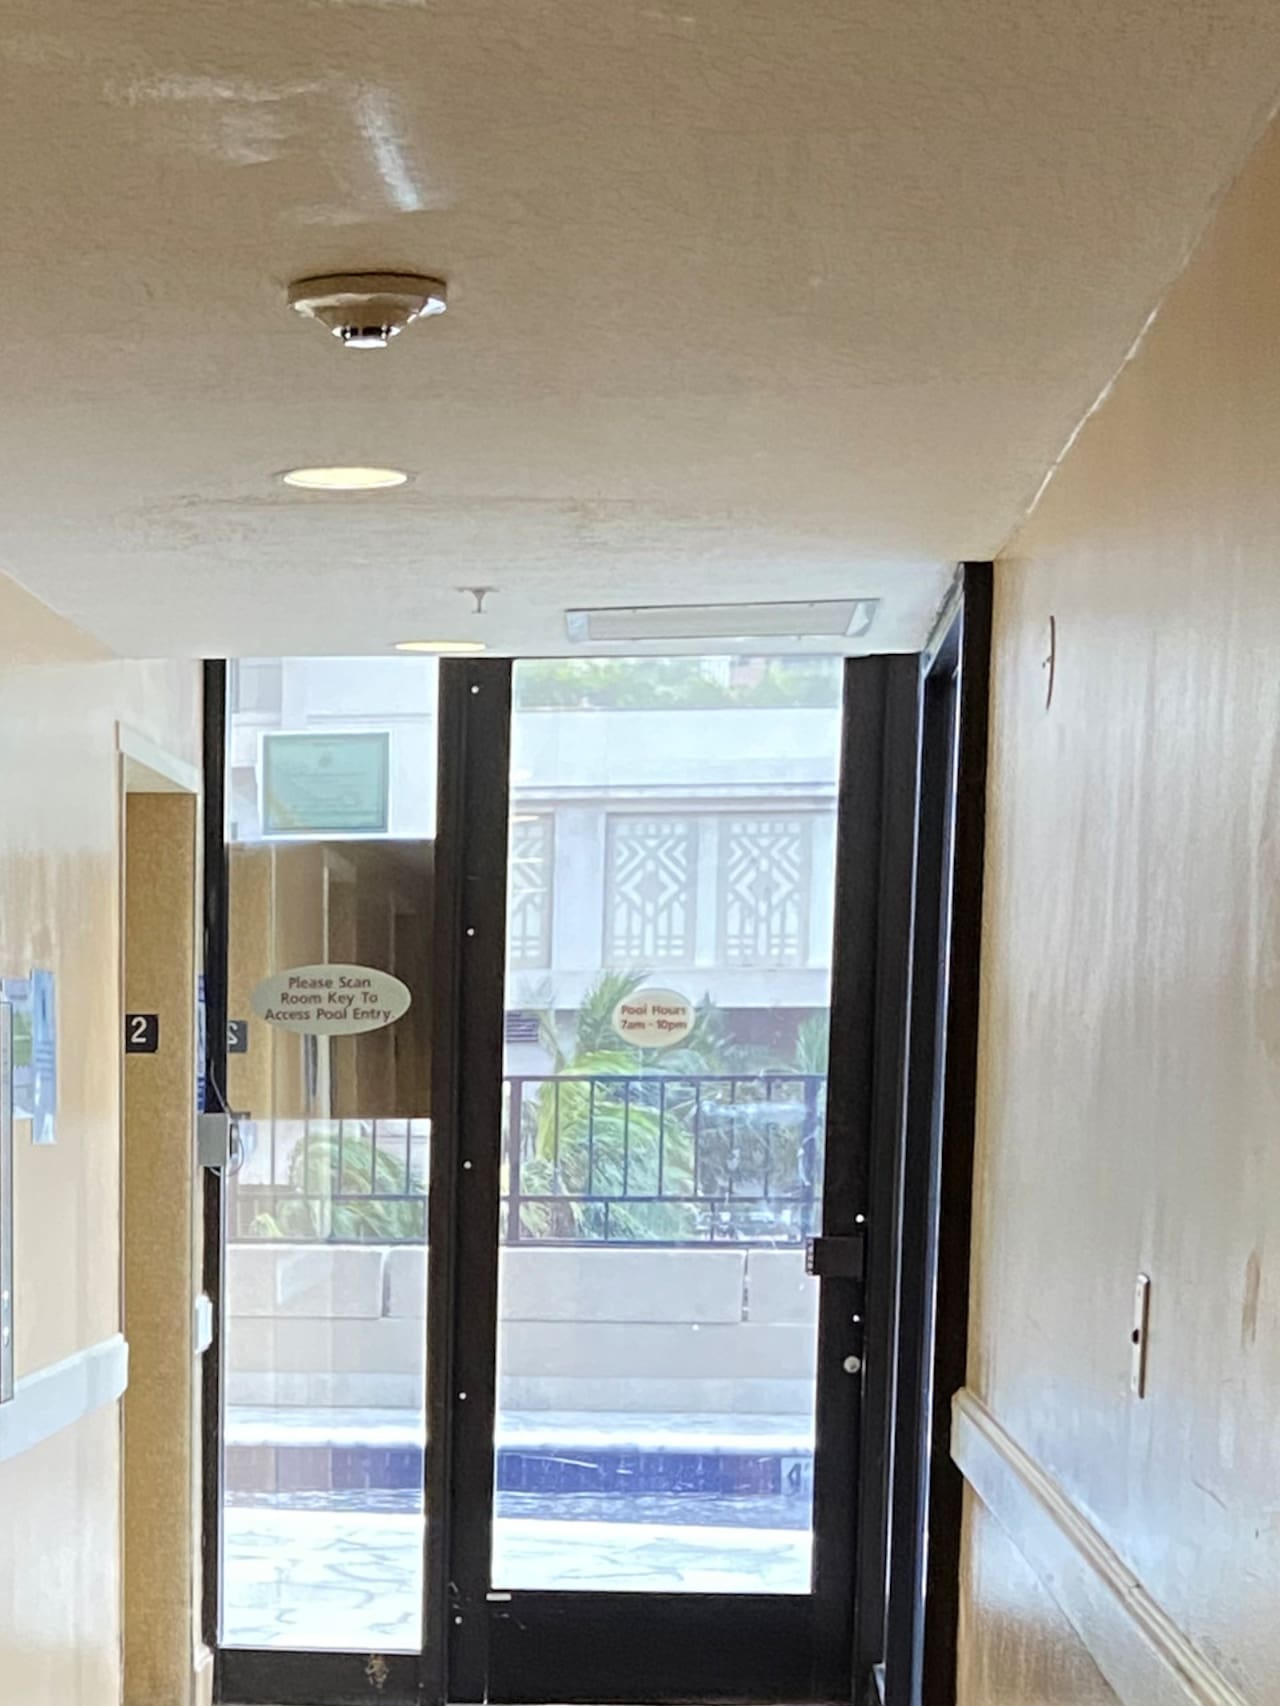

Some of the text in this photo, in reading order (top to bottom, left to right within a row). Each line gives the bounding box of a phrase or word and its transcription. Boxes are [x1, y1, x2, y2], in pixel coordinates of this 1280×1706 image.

[288, 976, 371, 989] Please Scan
[280, 991, 378, 1009] Room Key To
[264, 1008, 310, 1021] Access
[316, 1007, 347, 1020] Pool
[621, 1003, 686, 1015] Pool Hours
[131, 1016, 147, 1043] 2
[622, 1019, 646, 1030] 7am
[656, 1019, 688, 1032] 10pm
